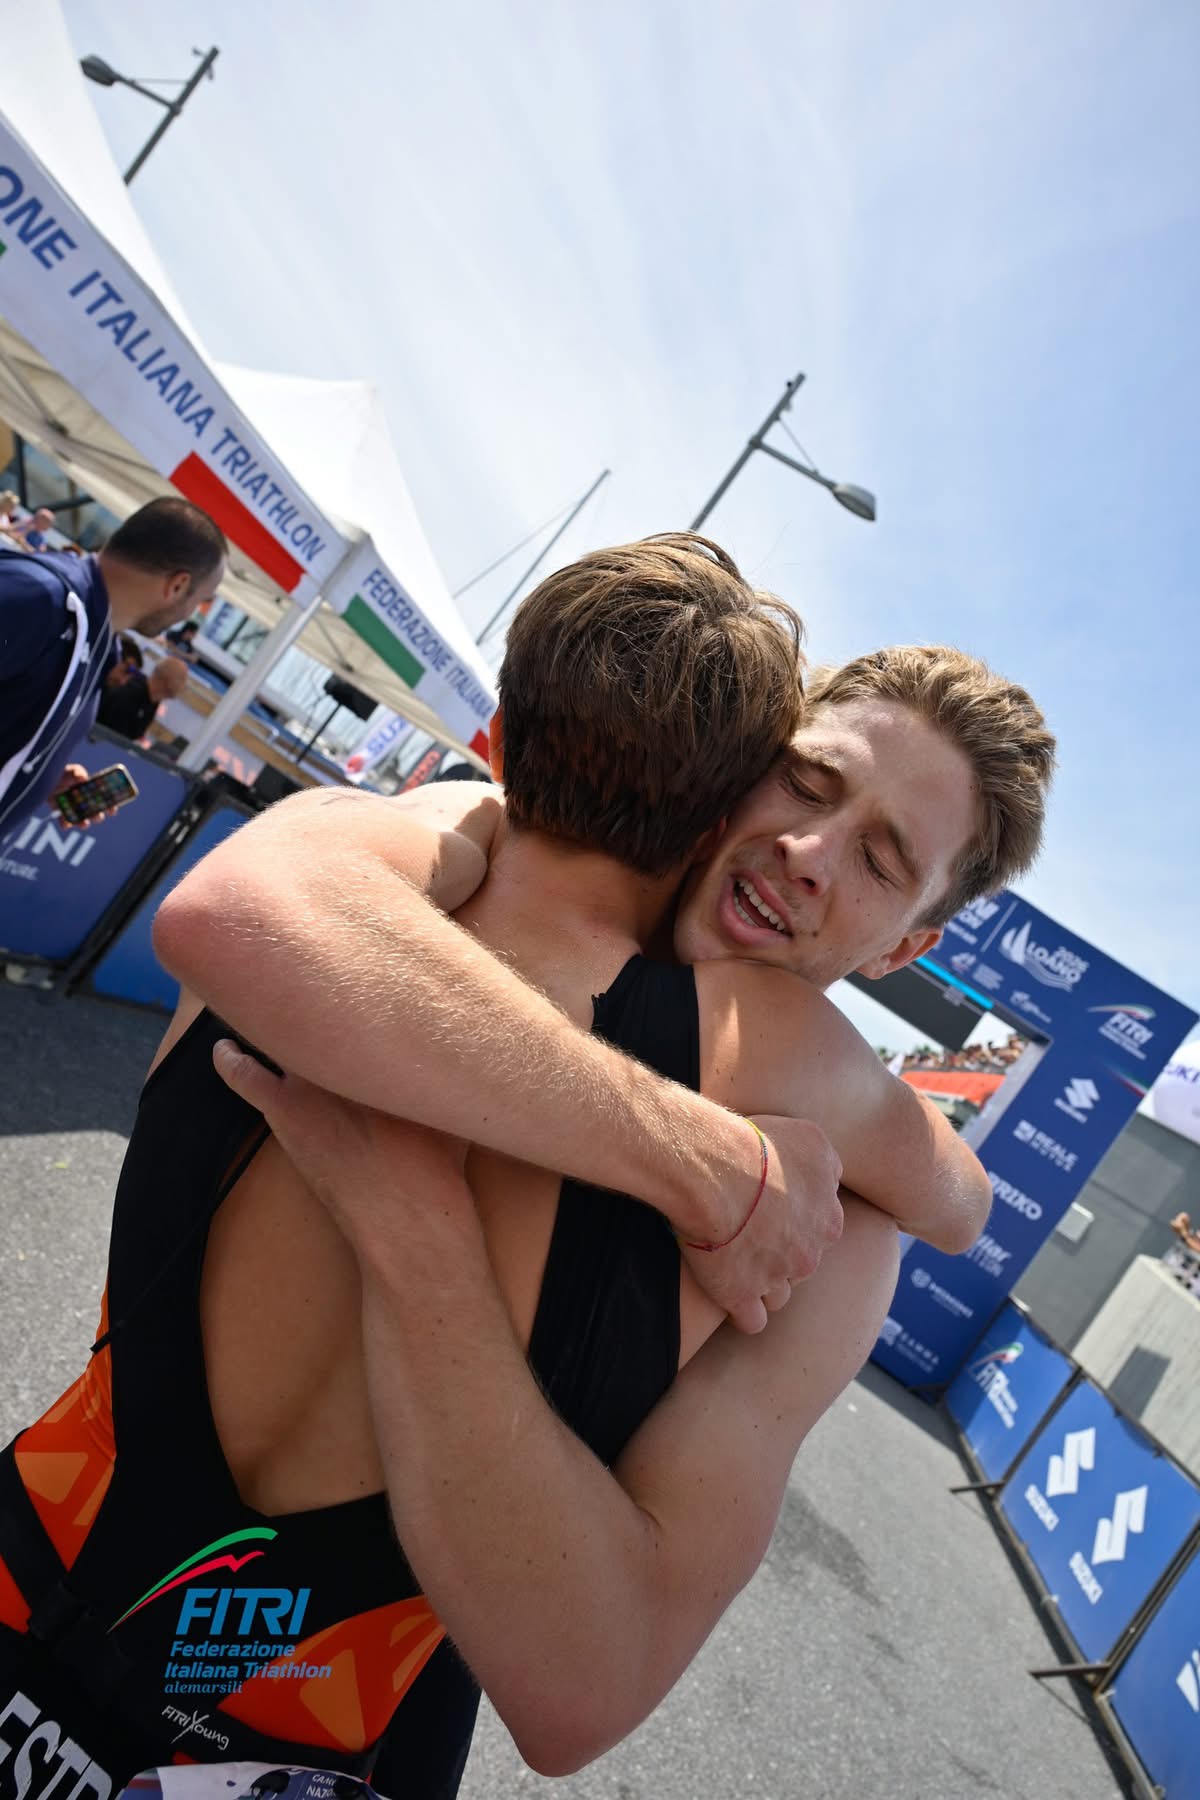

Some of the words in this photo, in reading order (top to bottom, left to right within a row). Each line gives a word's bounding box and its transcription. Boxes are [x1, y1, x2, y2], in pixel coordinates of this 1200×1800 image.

[69, 271, 217, 438] ITALIANA
[210, 427, 326, 562] TRIATHLON
[362, 567, 453, 673] FEDERAZIONE
[1027, 941, 1083, 984] LOANO
